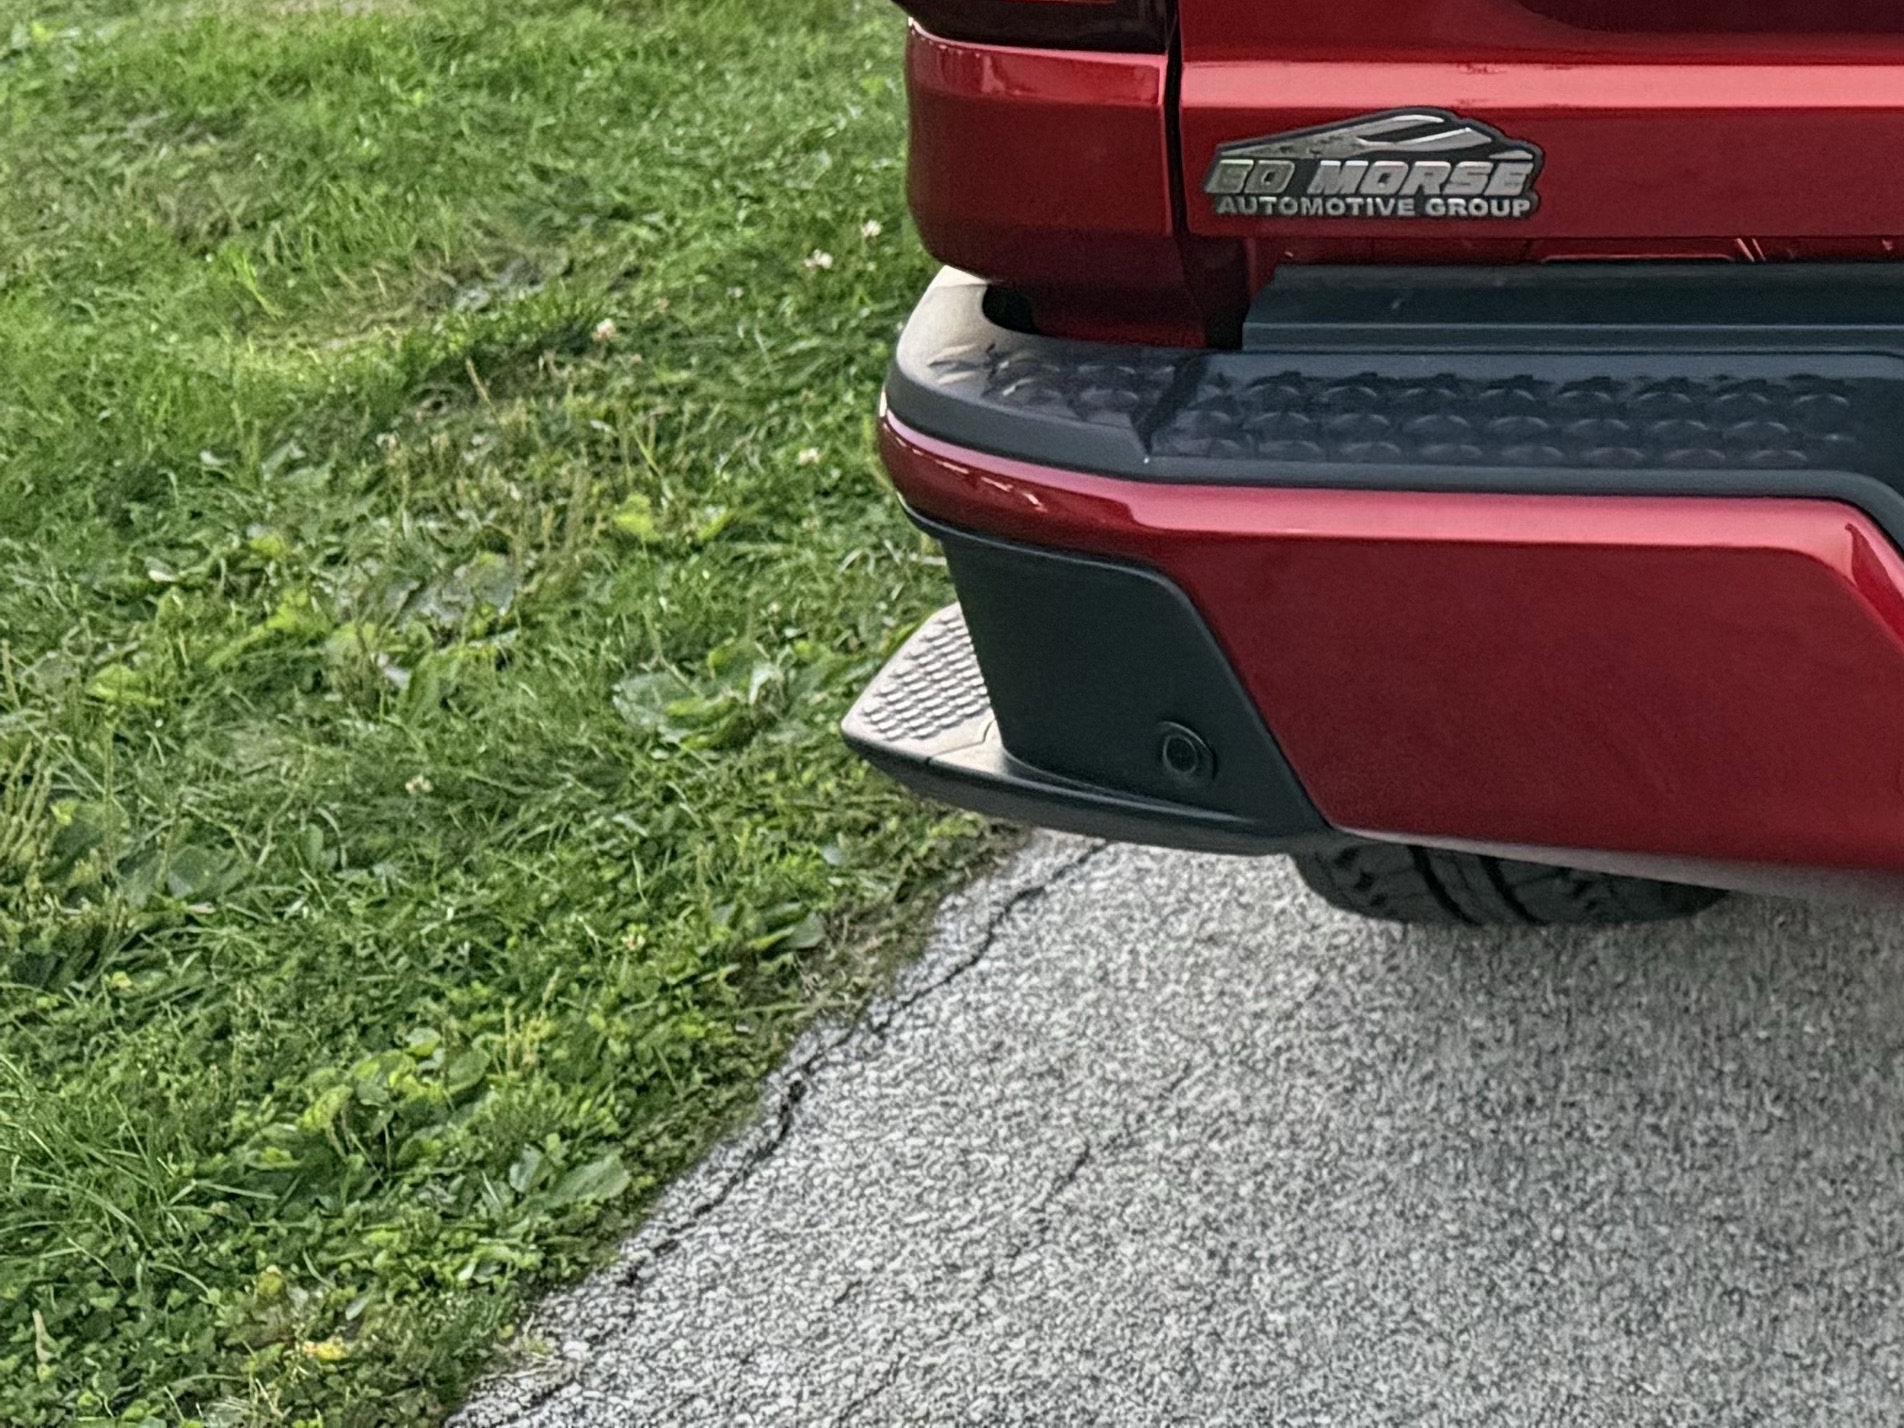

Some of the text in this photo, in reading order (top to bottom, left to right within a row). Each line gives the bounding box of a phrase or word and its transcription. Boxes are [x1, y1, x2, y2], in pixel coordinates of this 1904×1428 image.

[1205, 158, 1534, 196] ED MORSE
[1217, 196, 1531, 218] AUTOMOTIVE GROUP
